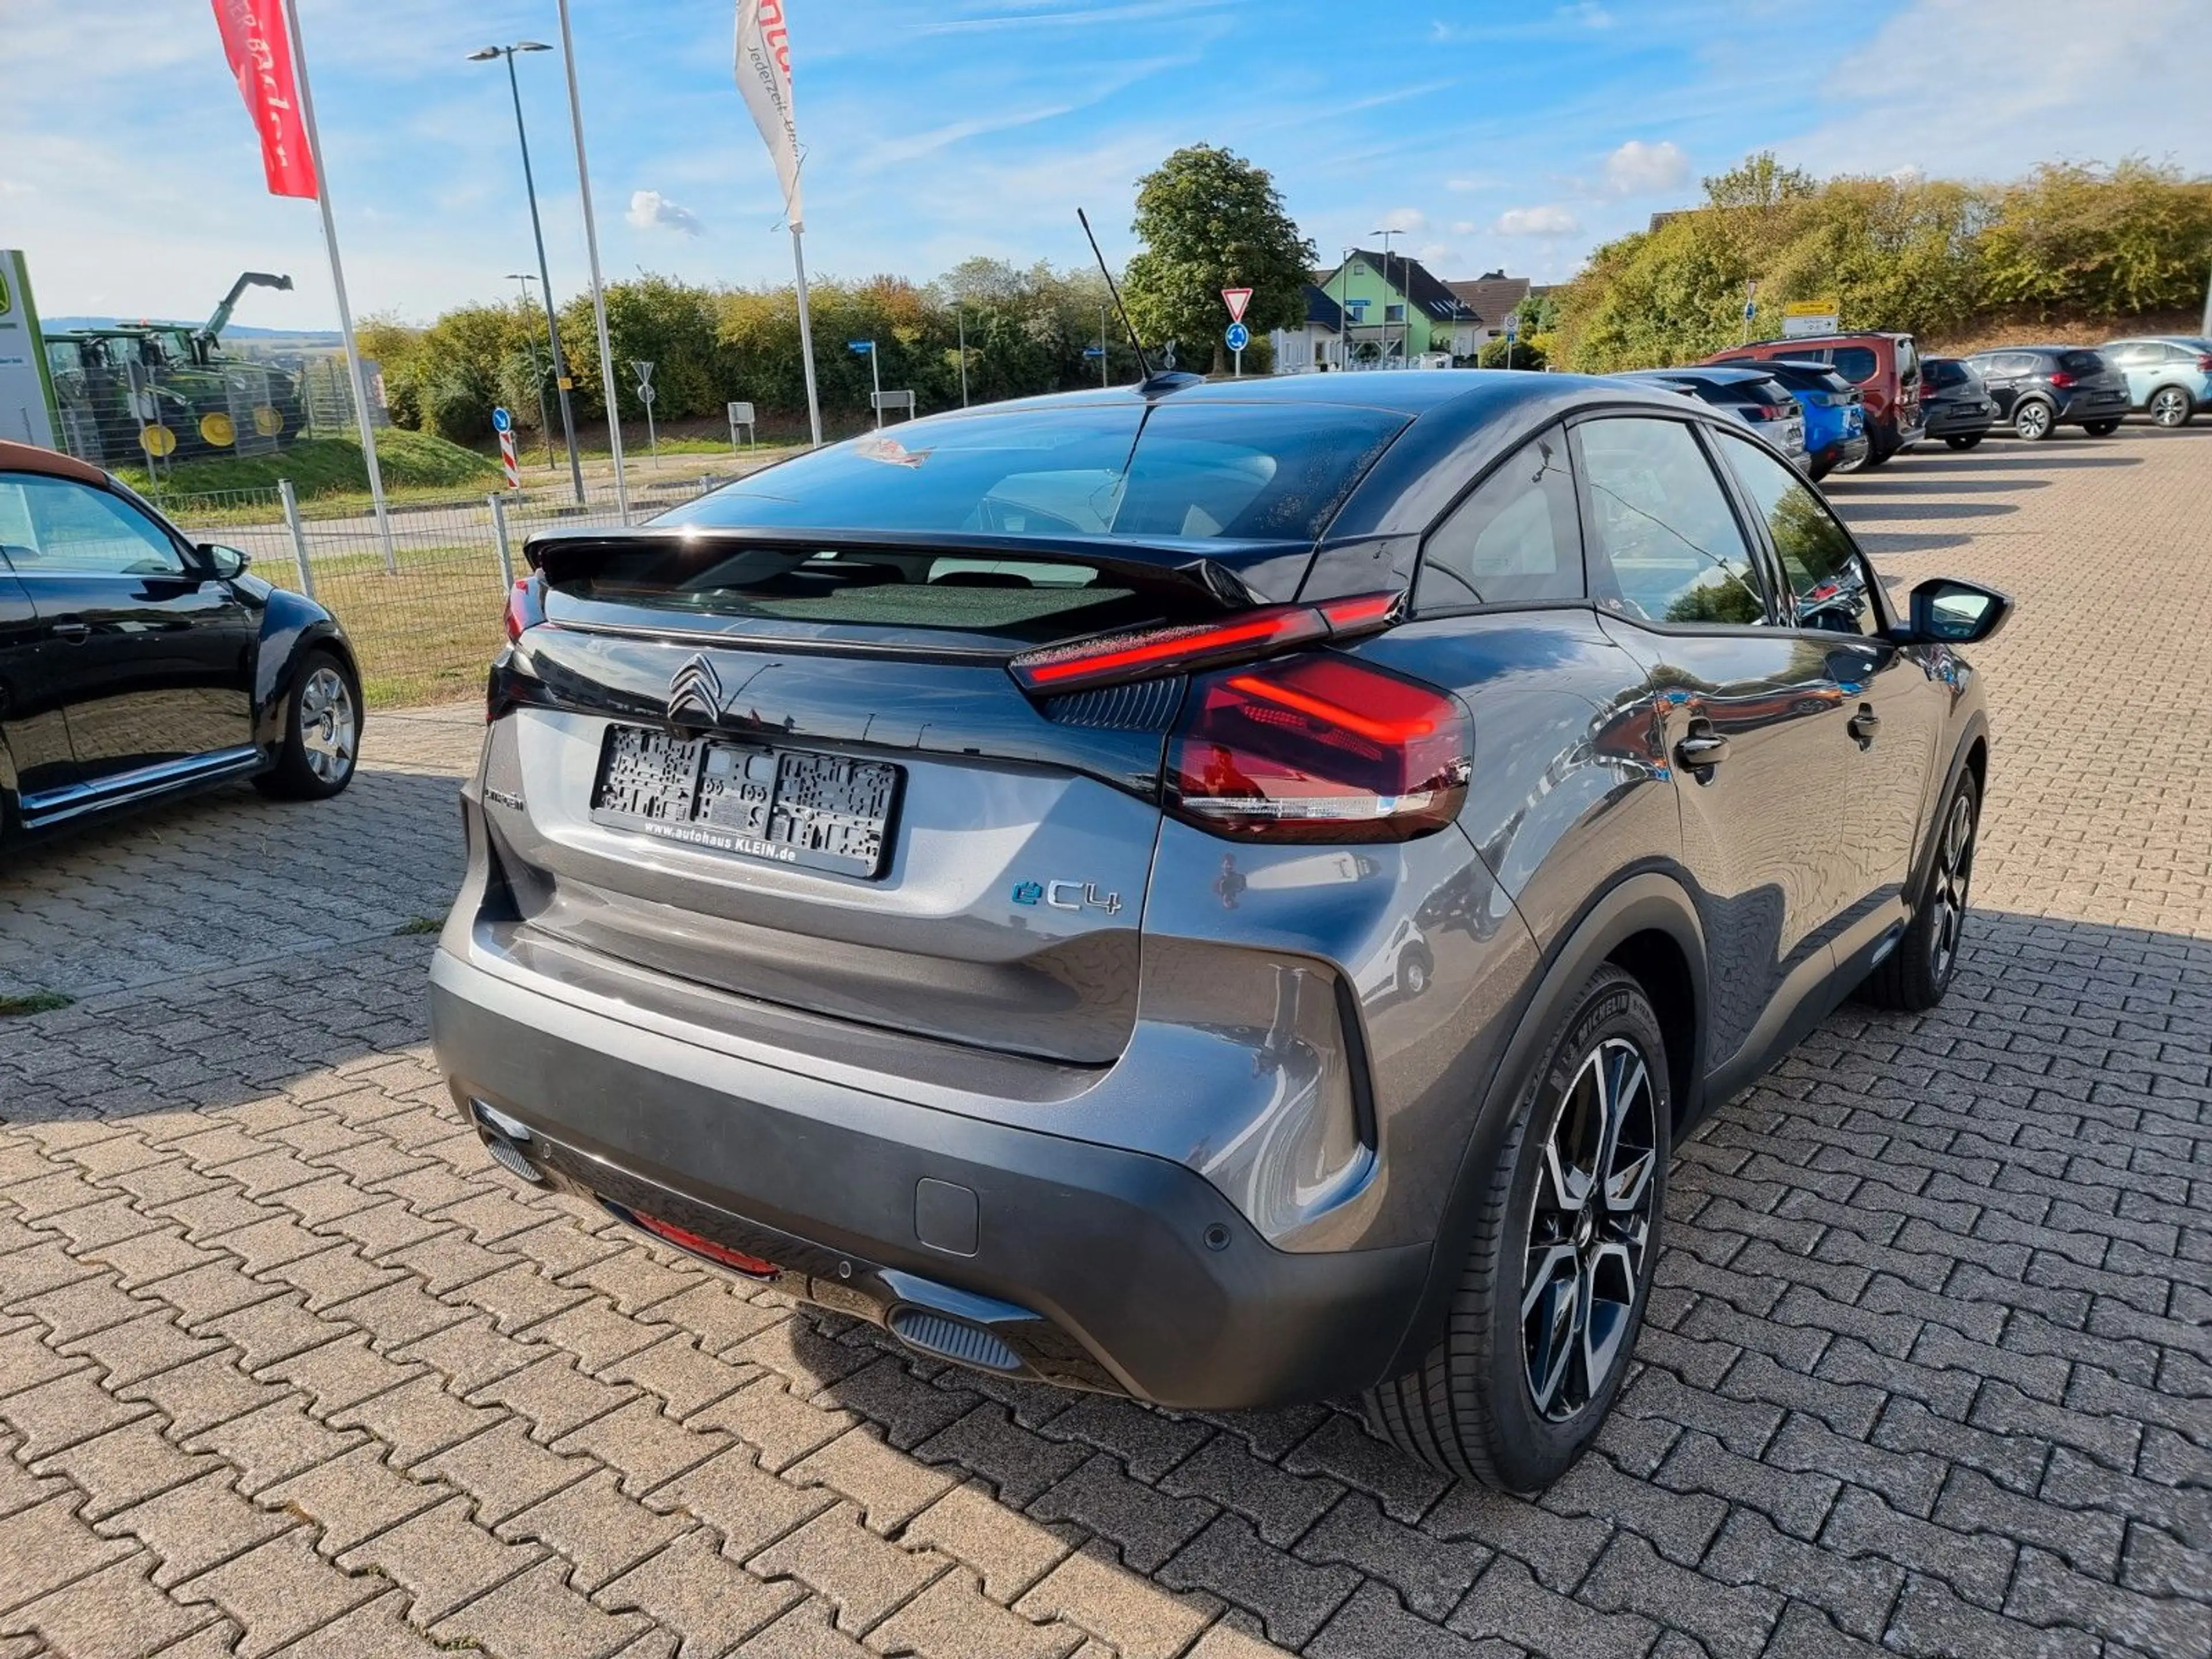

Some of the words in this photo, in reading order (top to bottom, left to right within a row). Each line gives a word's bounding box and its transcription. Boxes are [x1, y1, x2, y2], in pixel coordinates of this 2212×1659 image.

[645, 822, 732, 849] www.autohaus
[735, 838, 797, 861] KLEIN.de
[1578, 994, 1629, 1045] MICHELIN
